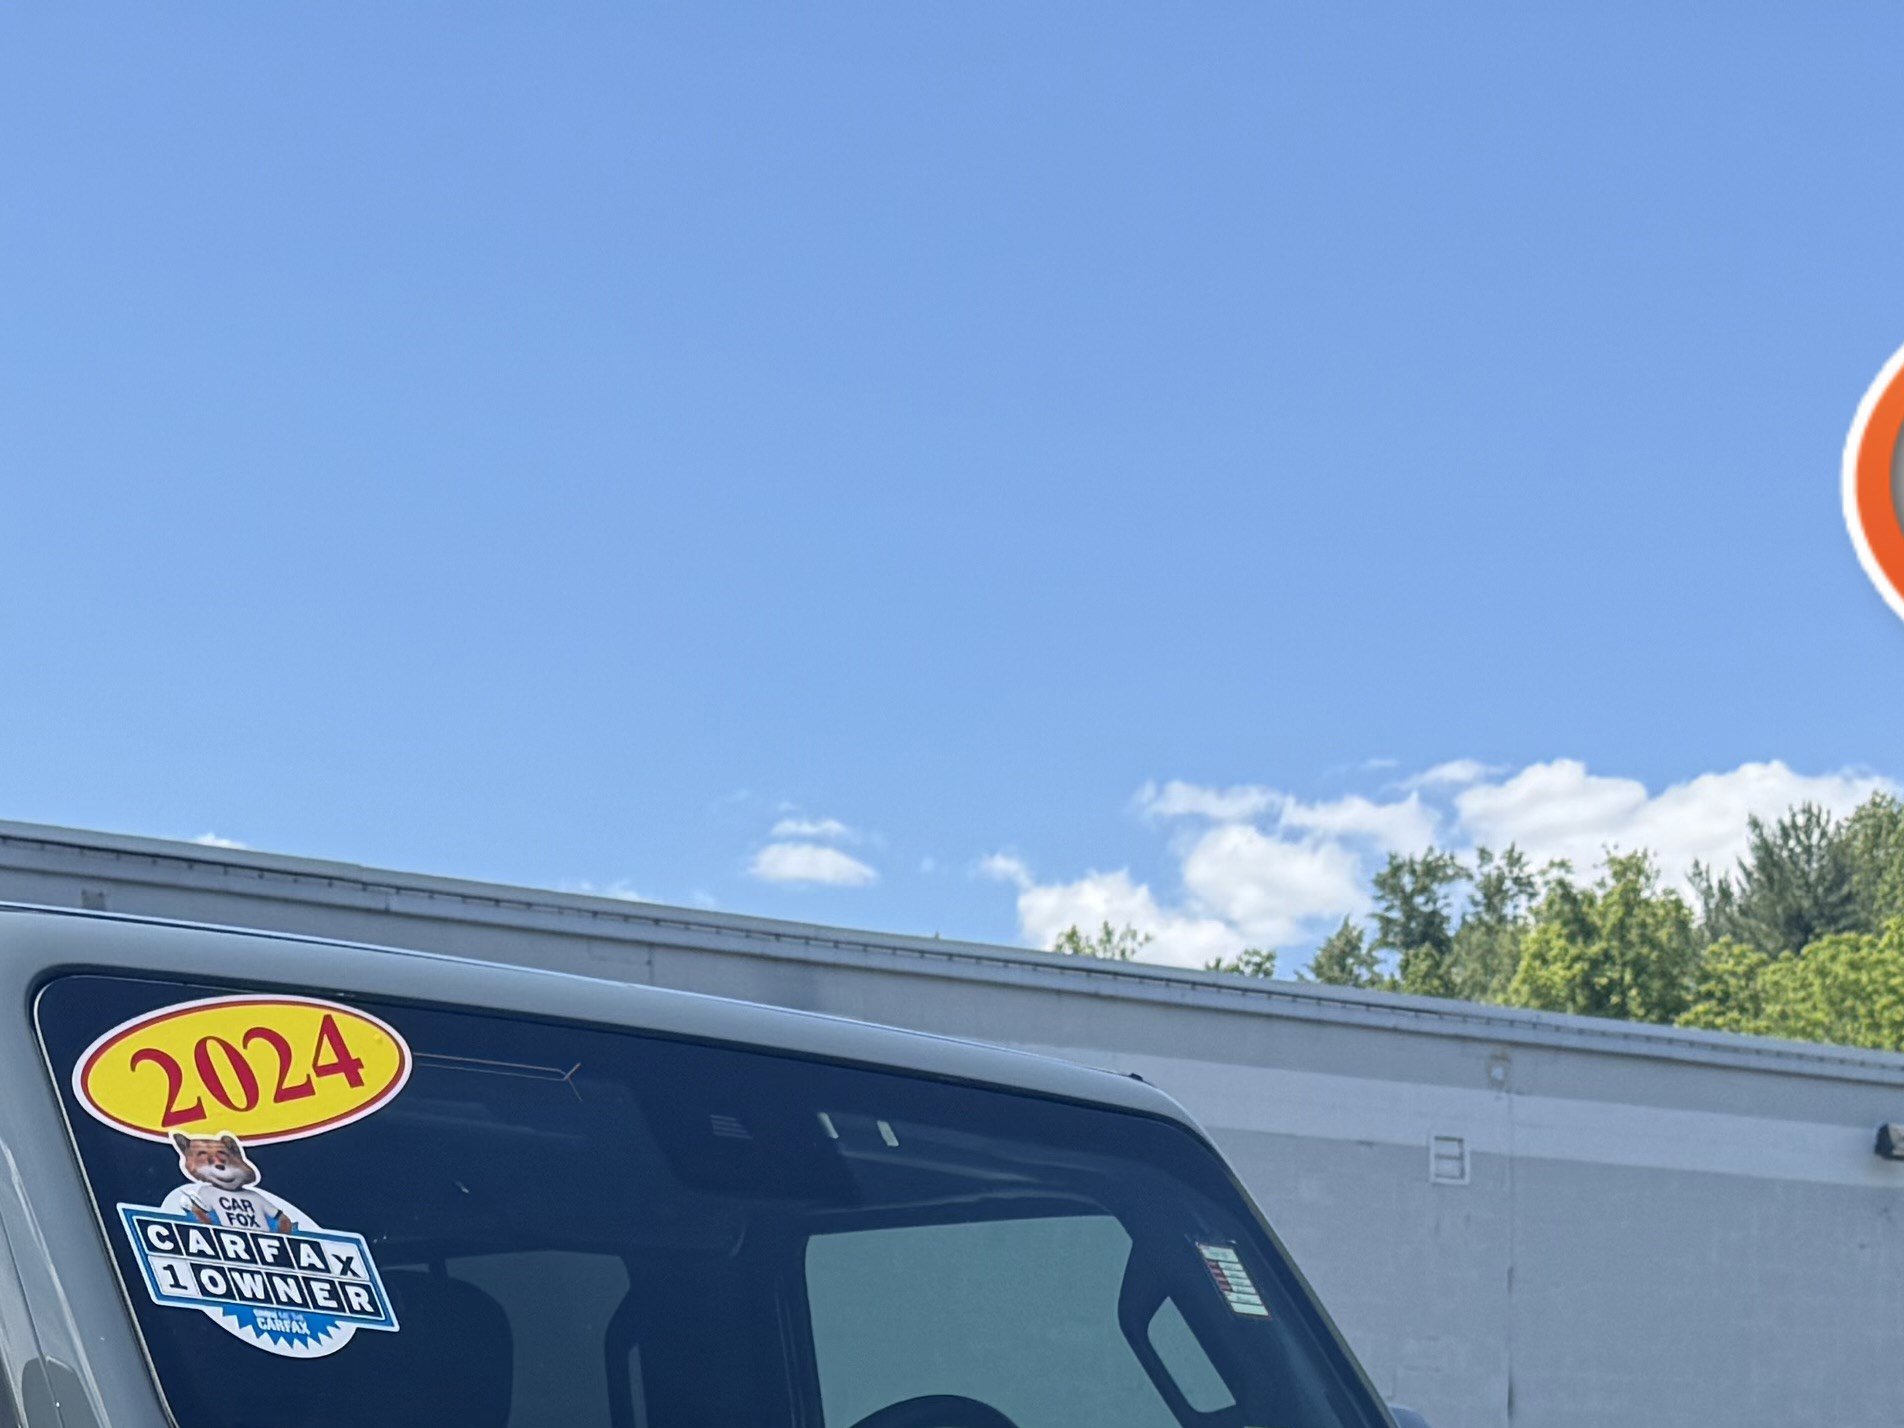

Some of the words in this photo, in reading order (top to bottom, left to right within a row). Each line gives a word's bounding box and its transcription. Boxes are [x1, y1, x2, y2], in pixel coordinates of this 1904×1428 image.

[130, 1014, 364, 1128] 2024
[219, 1197, 255, 1213] CAR
[226, 1212, 261, 1228] FOX
[146, 1223, 366, 1278] CARFAX
